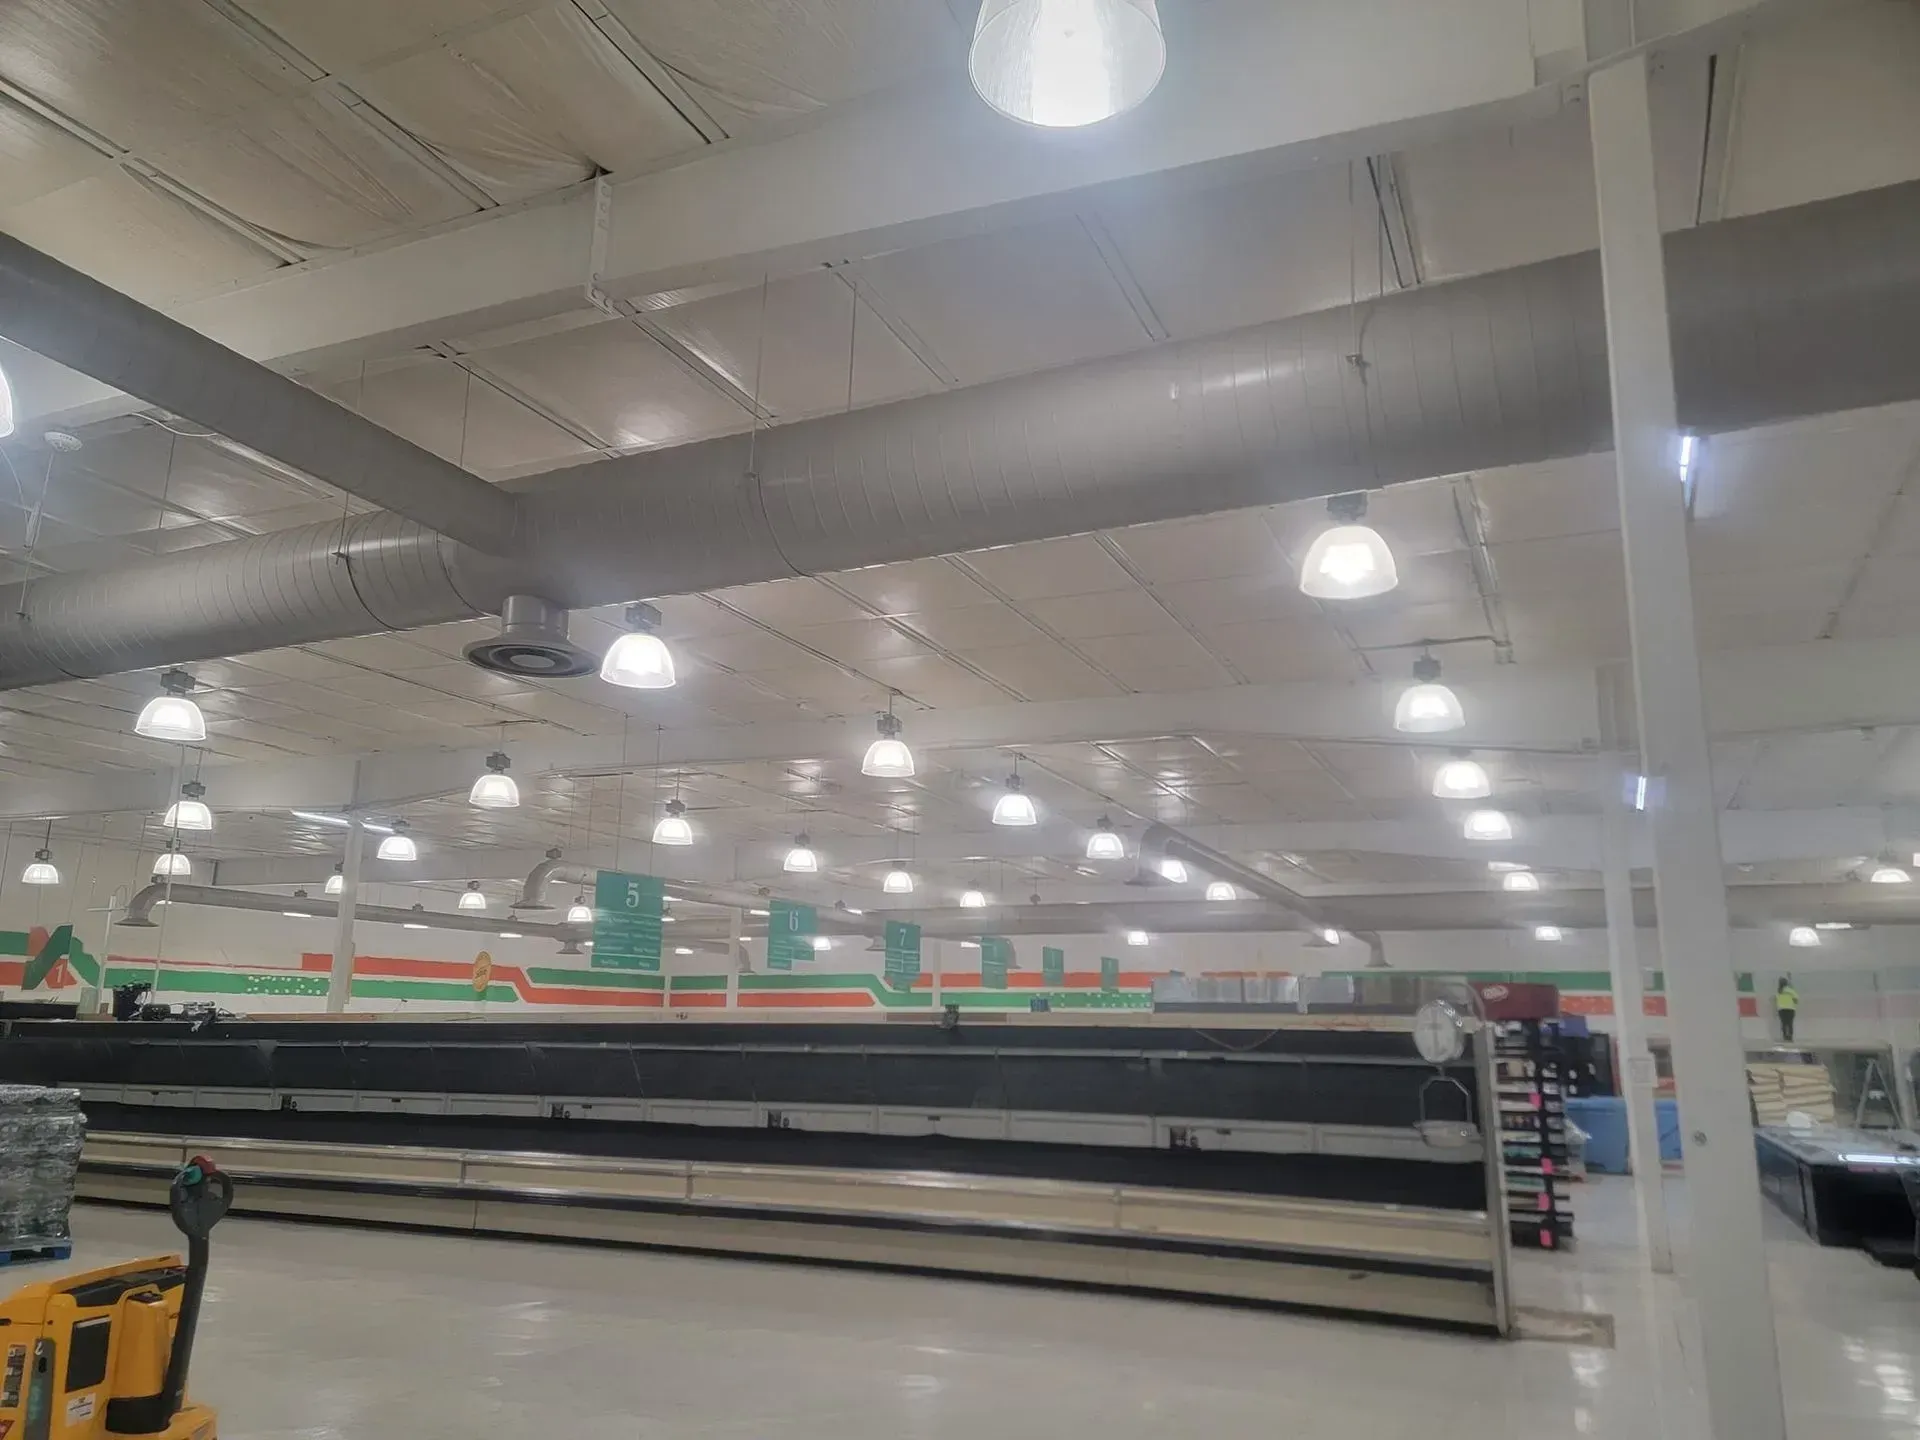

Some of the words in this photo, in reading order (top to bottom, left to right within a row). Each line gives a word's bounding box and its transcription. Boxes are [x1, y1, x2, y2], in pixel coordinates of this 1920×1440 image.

[625, 881, 640, 909] 5
[788, 909, 800, 932] 6
[899, 928, 907, 947] 7
